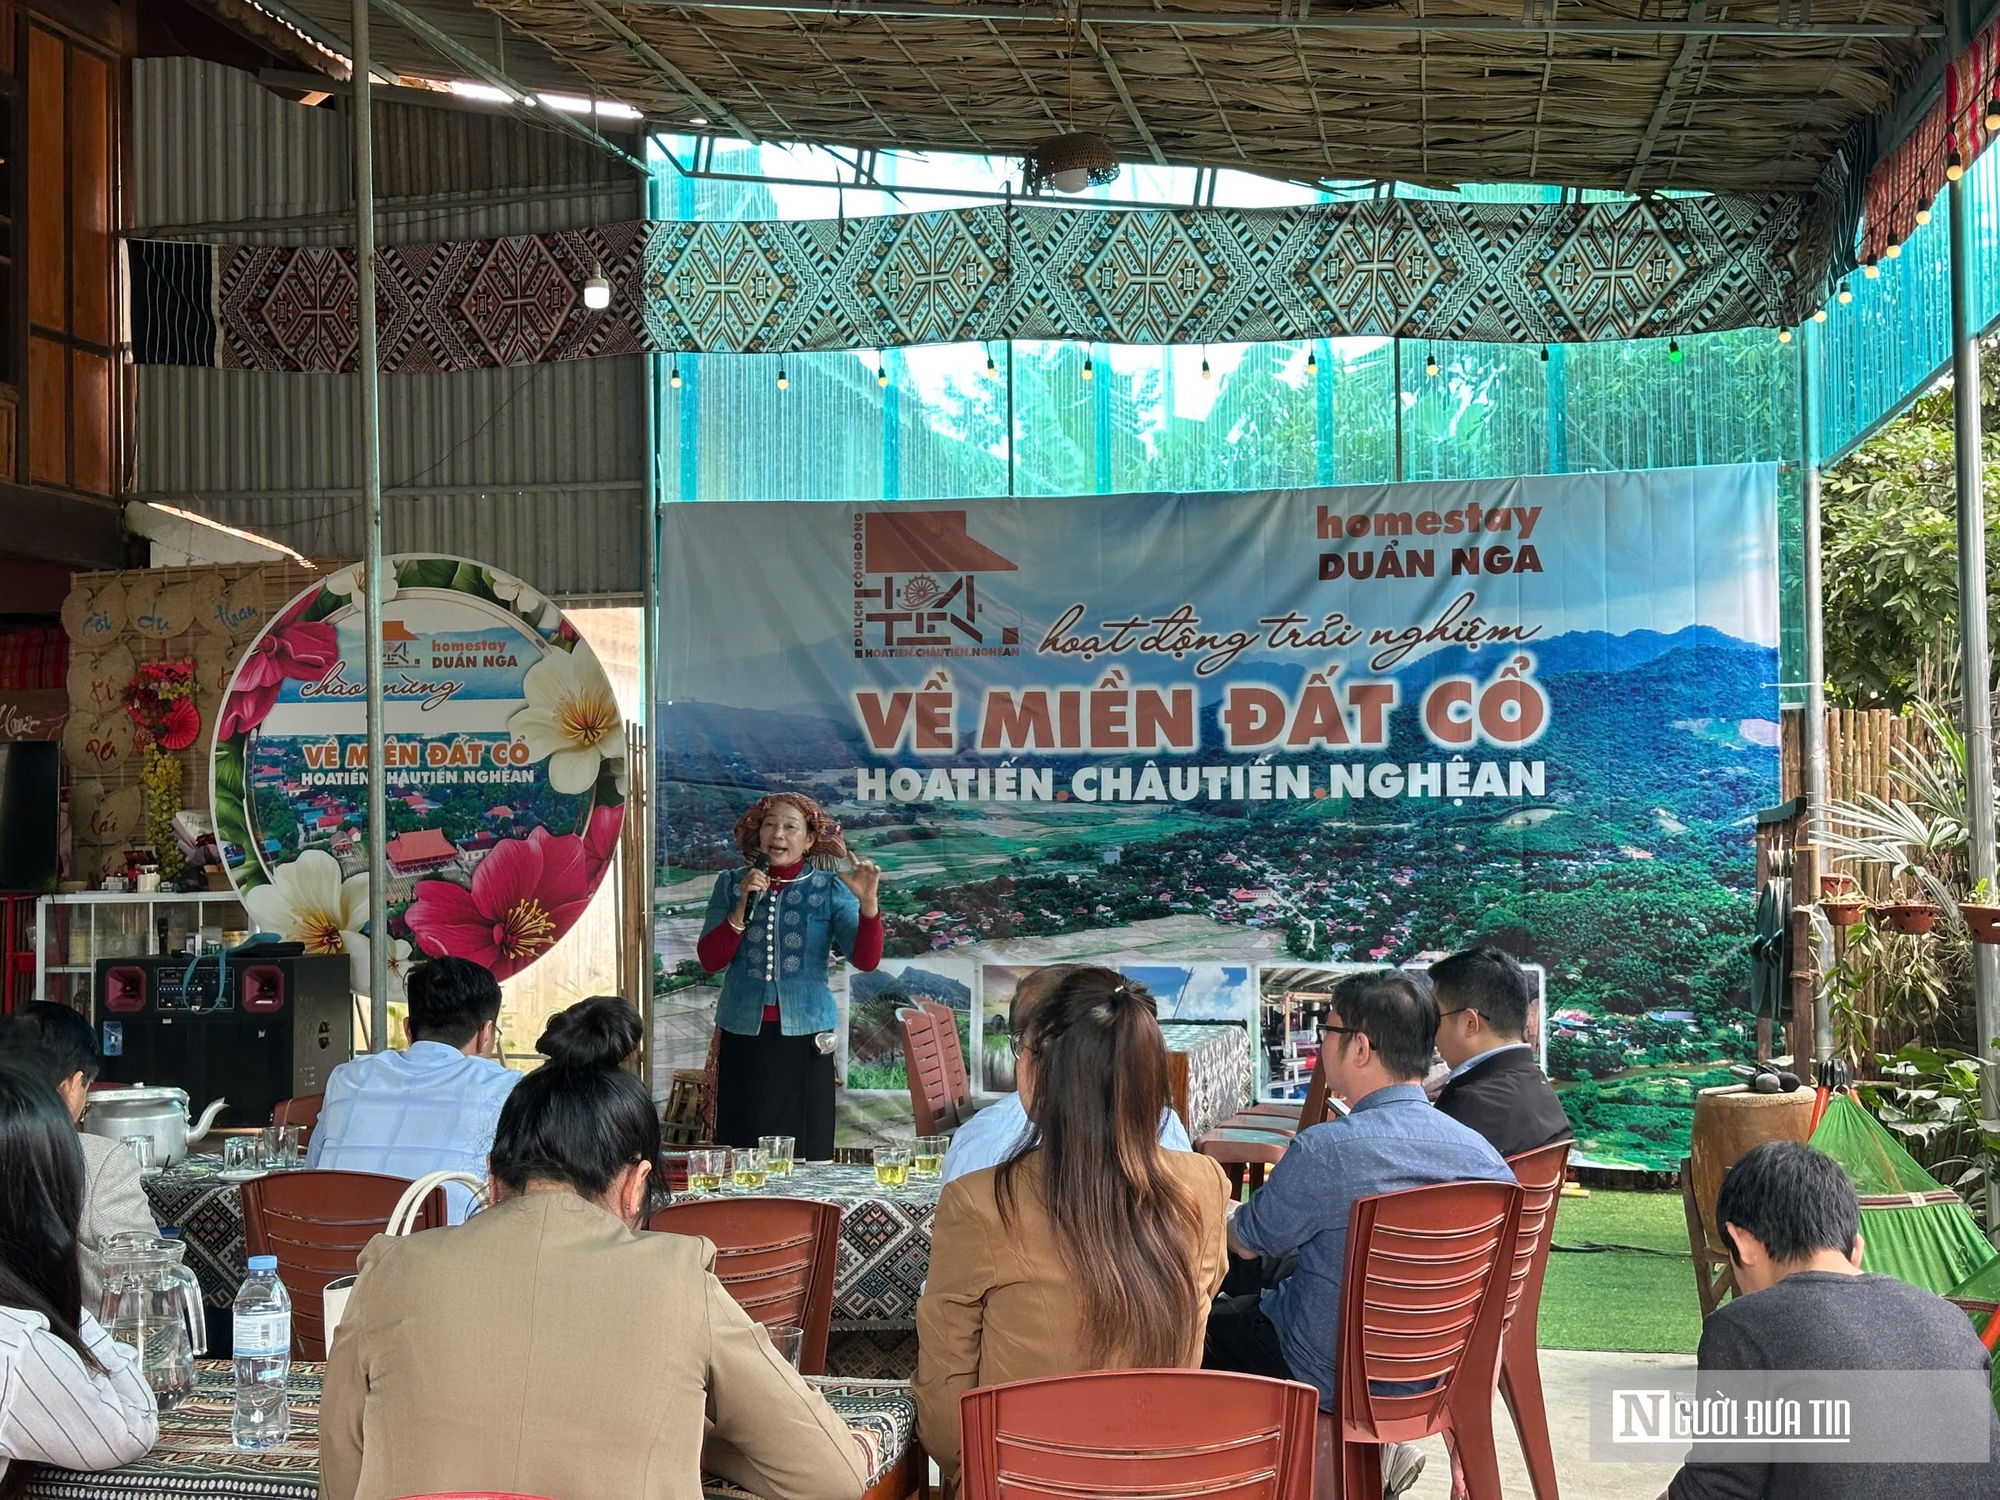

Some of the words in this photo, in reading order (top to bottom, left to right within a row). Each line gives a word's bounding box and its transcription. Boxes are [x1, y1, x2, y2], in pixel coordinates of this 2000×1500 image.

[1317, 502, 1543, 539] homestay
[1319, 539, 1435, 581] DUẨN
[1452, 544, 1544, 576] NGA
[432, 640, 507, 654] homestay
[1039, 604, 1151, 660] hoạt
[1140, 605, 1261, 676] động
[1260, 613, 1363, 649] trải
[1371, 592, 1543, 671] nghiệm
[301, 661, 367, 697] chào
[483, 655, 518, 667] NGA
[856, 672, 953, 749] VỀ
[981, 669, 1193, 748] MIỀN
[1224, 665, 1394, 746] ĐẤT
[1425, 656, 1544, 744] CỔ
[304, 739, 339, 768] VỀ
[347, 737, 419, 766] MỀN
[427, 737, 483, 766] ĐẤT
[493, 735, 530, 765] CỔ
